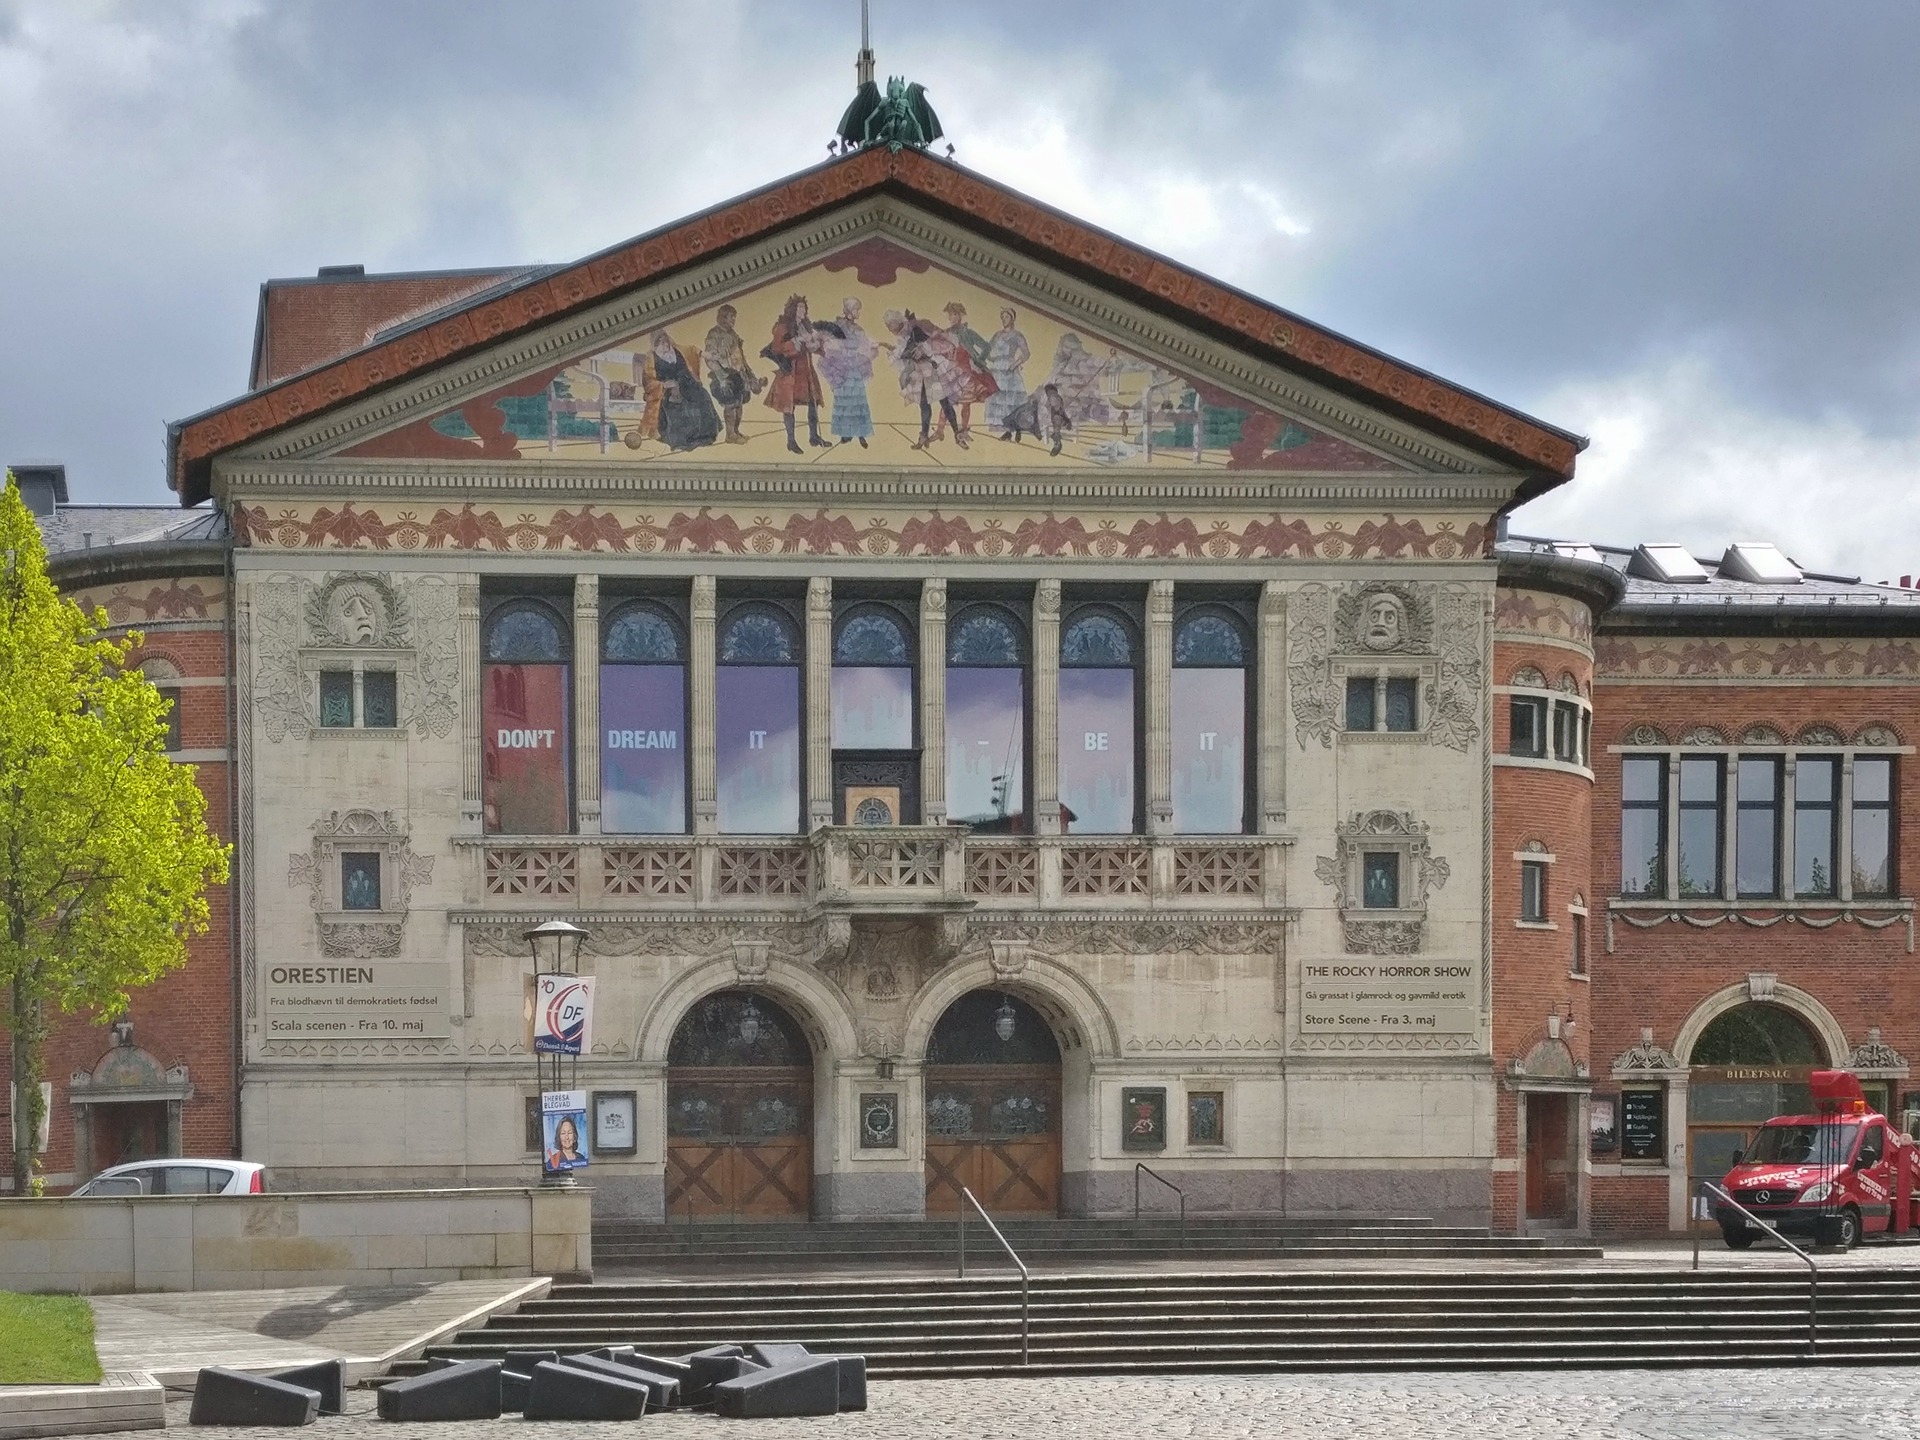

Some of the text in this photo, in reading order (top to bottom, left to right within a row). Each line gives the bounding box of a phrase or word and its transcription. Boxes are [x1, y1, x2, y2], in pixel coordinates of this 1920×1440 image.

[497, 729, 555, 749] DON'T
[608, 730, 676, 749] DREAM
[749, 730, 767, 749] IT
[1084, 732, 1108, 751] BE
[1199, 732, 1218, 751] IT
[270, 967, 374, 984] ORESTIEN
[1306, 966, 1471, 977] THE ROCKY HORROR SHOW
[270, 996, 438, 1006] Fra blodhævn til demokratiets fødsel
[1319, 992, 1349, 1001] grassat
[1355, 991, 1394, 1001] glamrock
[1395, 993, 1406, 1001] og
[1408, 991, 1440, 1001] gavmild
[1442, 991, 1467, 1000] erotik
[563, 1005, 584, 1021] DF
[271, 1020, 302, 1031] Scala
[306, 1022, 347, 1031] scenen
[359, 1020, 378, 1030] Fra
[382, 1020, 398, 1030] 10.
[402, 1020, 424, 1032] maj
[1305, 1015, 1335, 1025] Store
[1338, 1015, 1371, 1025] Scene
[1381, 1015, 1399, 1025] Fra
[1402, 1015, 1413, 1025] 3.
[1415, 1015, 1436, 1027] maj
[544, 1094, 570, 1102] THERESA
[544, 1101, 571, 1109] BLEGVAD
